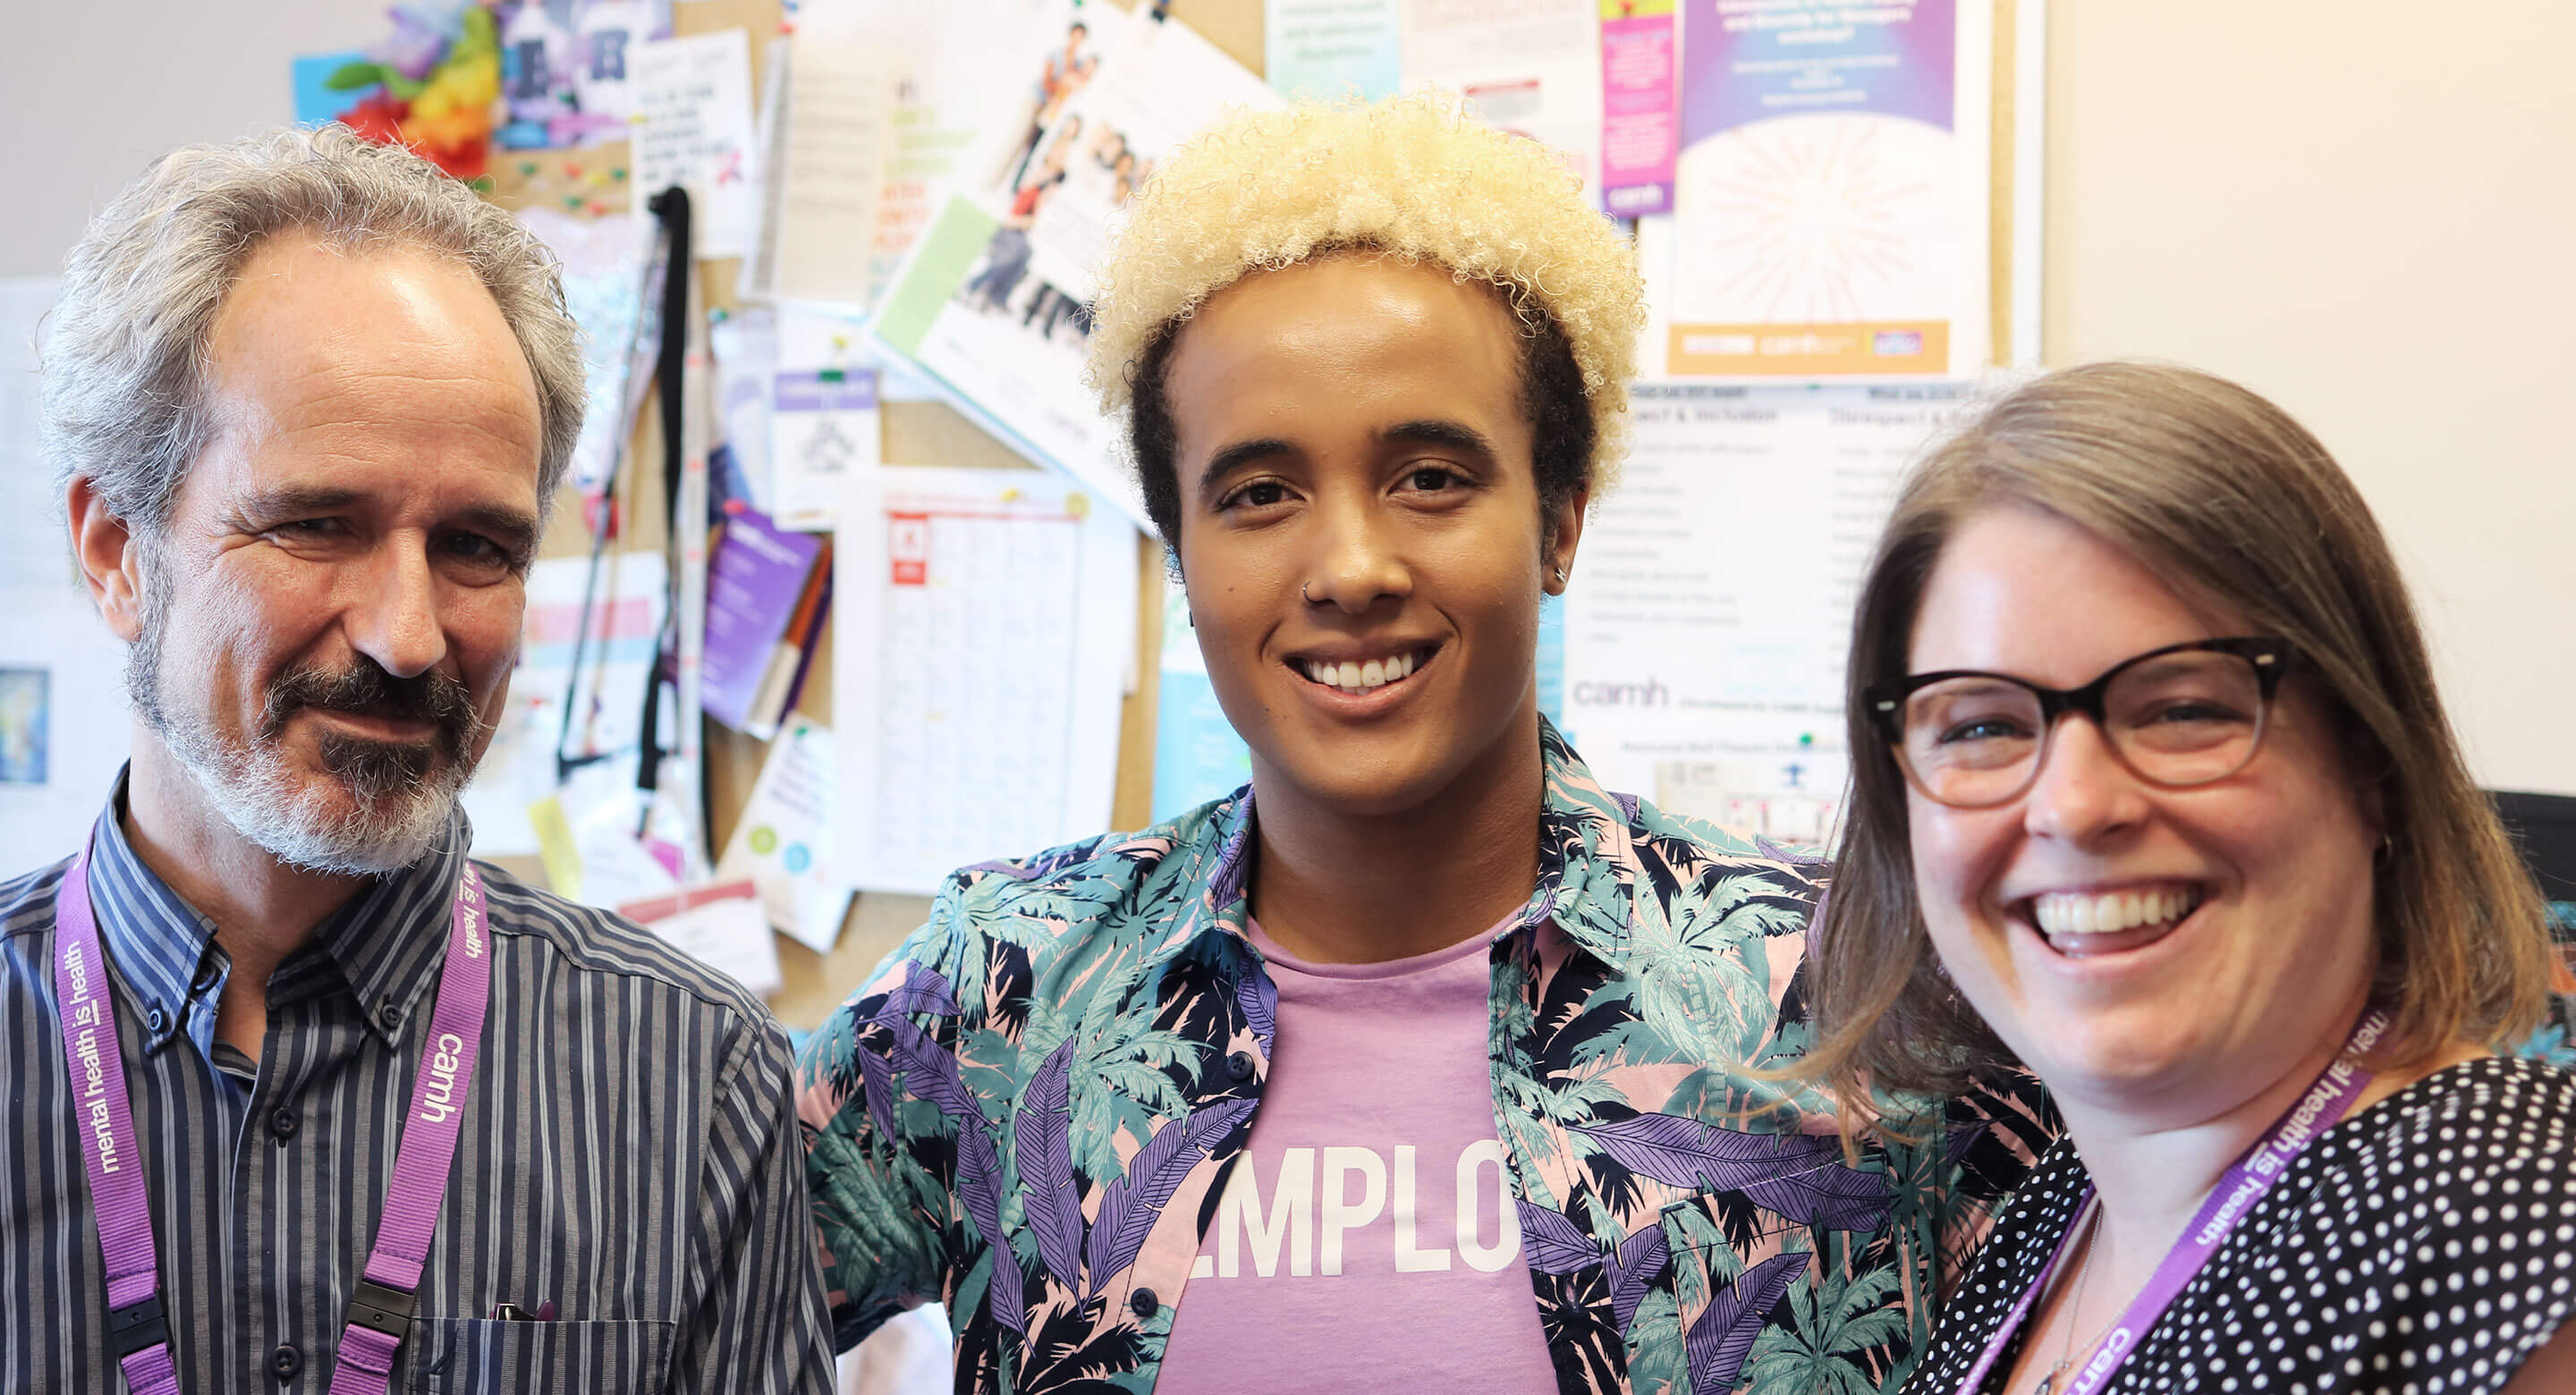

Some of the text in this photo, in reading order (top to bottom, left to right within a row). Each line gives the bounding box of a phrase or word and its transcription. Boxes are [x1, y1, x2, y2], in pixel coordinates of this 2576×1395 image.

[1573, 677, 1669, 706] camh
[459, 881, 479, 904] is
[463, 905, 483, 959] health
[64, 941, 120, 1174] mental health is health
[420, 1033, 462, 1123] camh
[2272, 1078, 2343, 1152] health
[2247, 1145, 2285, 1176] is
[2195, 1176, 2263, 1246] health
